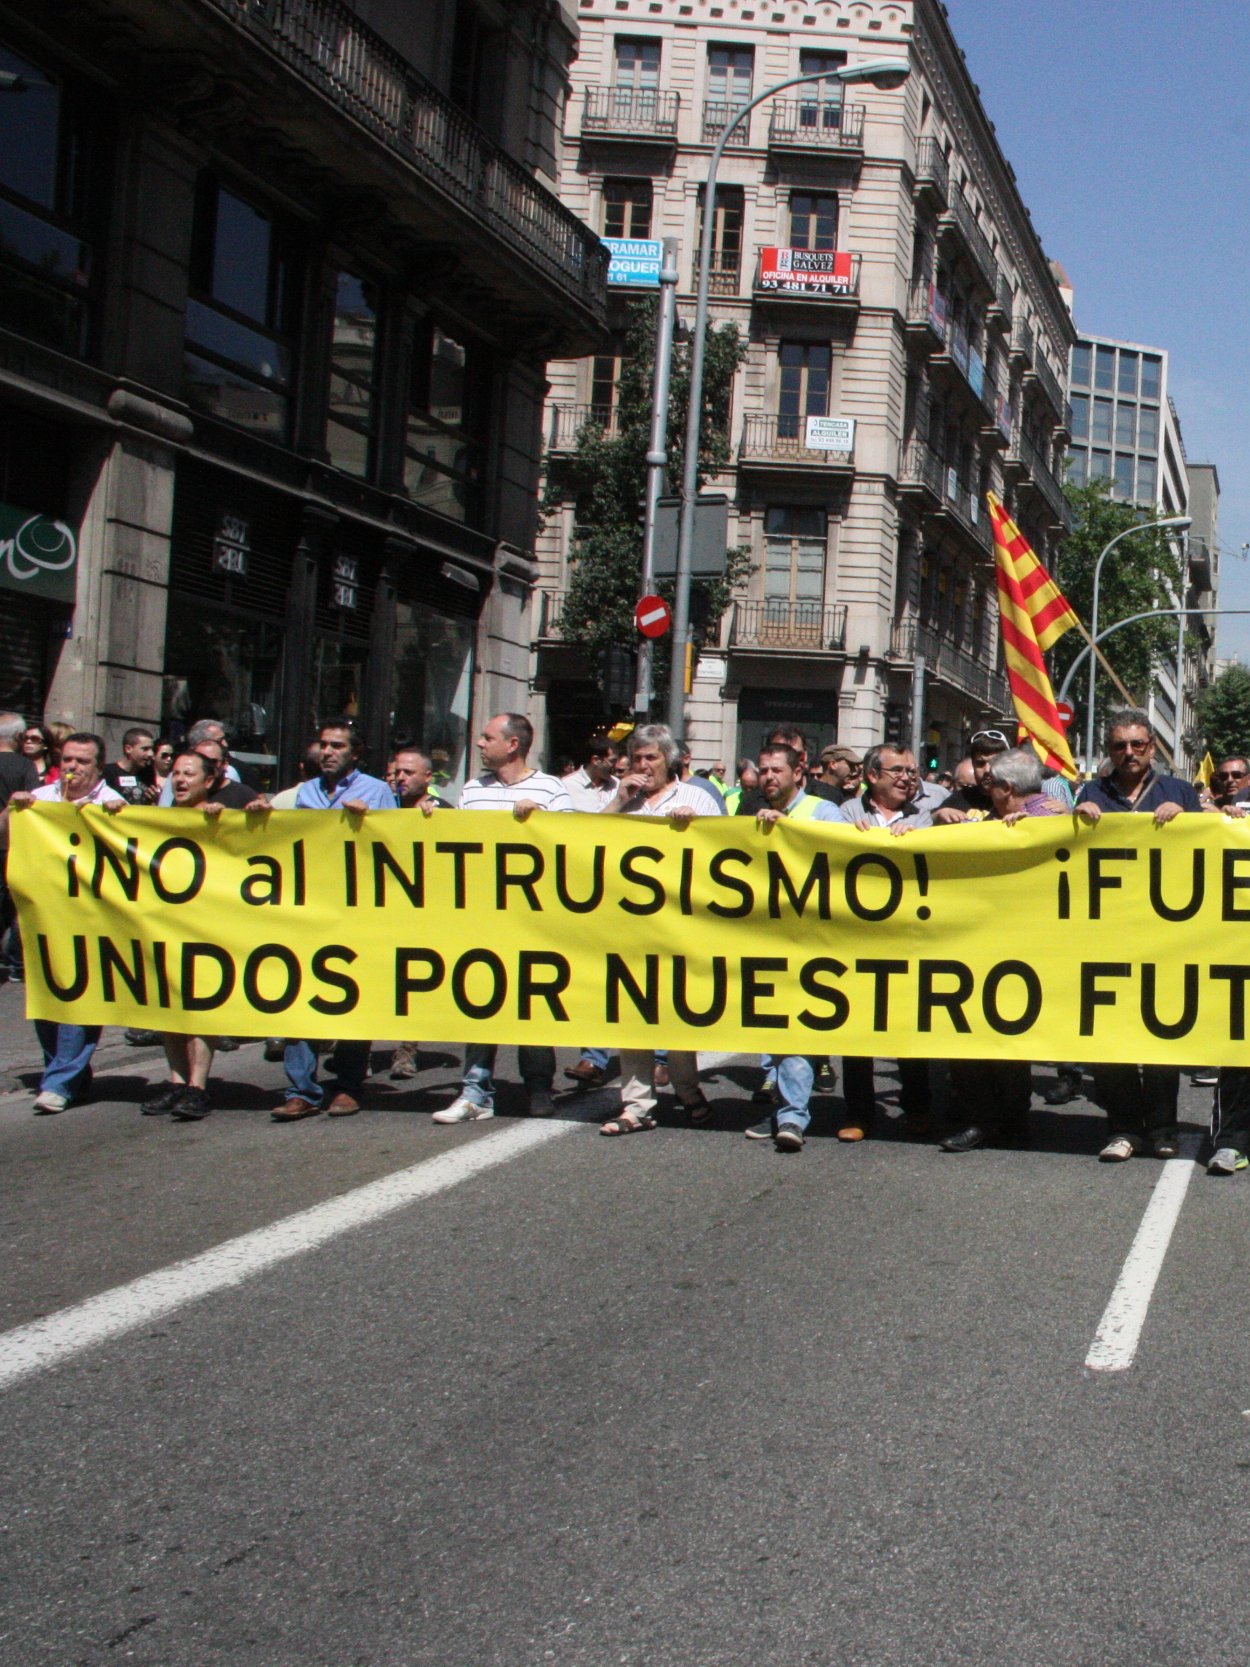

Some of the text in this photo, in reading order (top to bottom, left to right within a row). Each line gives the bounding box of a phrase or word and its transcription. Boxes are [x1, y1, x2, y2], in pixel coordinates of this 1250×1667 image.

[794, 251, 834, 262] BUSQUETS
[608, 260, 660, 274] OGUER
[793, 260, 833, 270] GALVEZ
[763, 271, 795, 281] OFICINA
[796, 273, 808, 282] EN
[808, 274, 849, 284] ALQUILER
[762, 280, 778, 289] 93
[782, 281, 806, 291] 481
[812, 283, 827, 292] 71
[833, 285, 848, 294] 71
[811, 430, 848, 438] ALQUILER
[67, 832, 207, 905] ¡NO
[240, 839, 306, 906] al
[344, 840, 932, 922] INTRUSISMO!
[37, 934, 360, 1016] UNIDOS
[395, 946, 571, 1021] POR
[605, 953, 1042, 1036] NUESTRO
